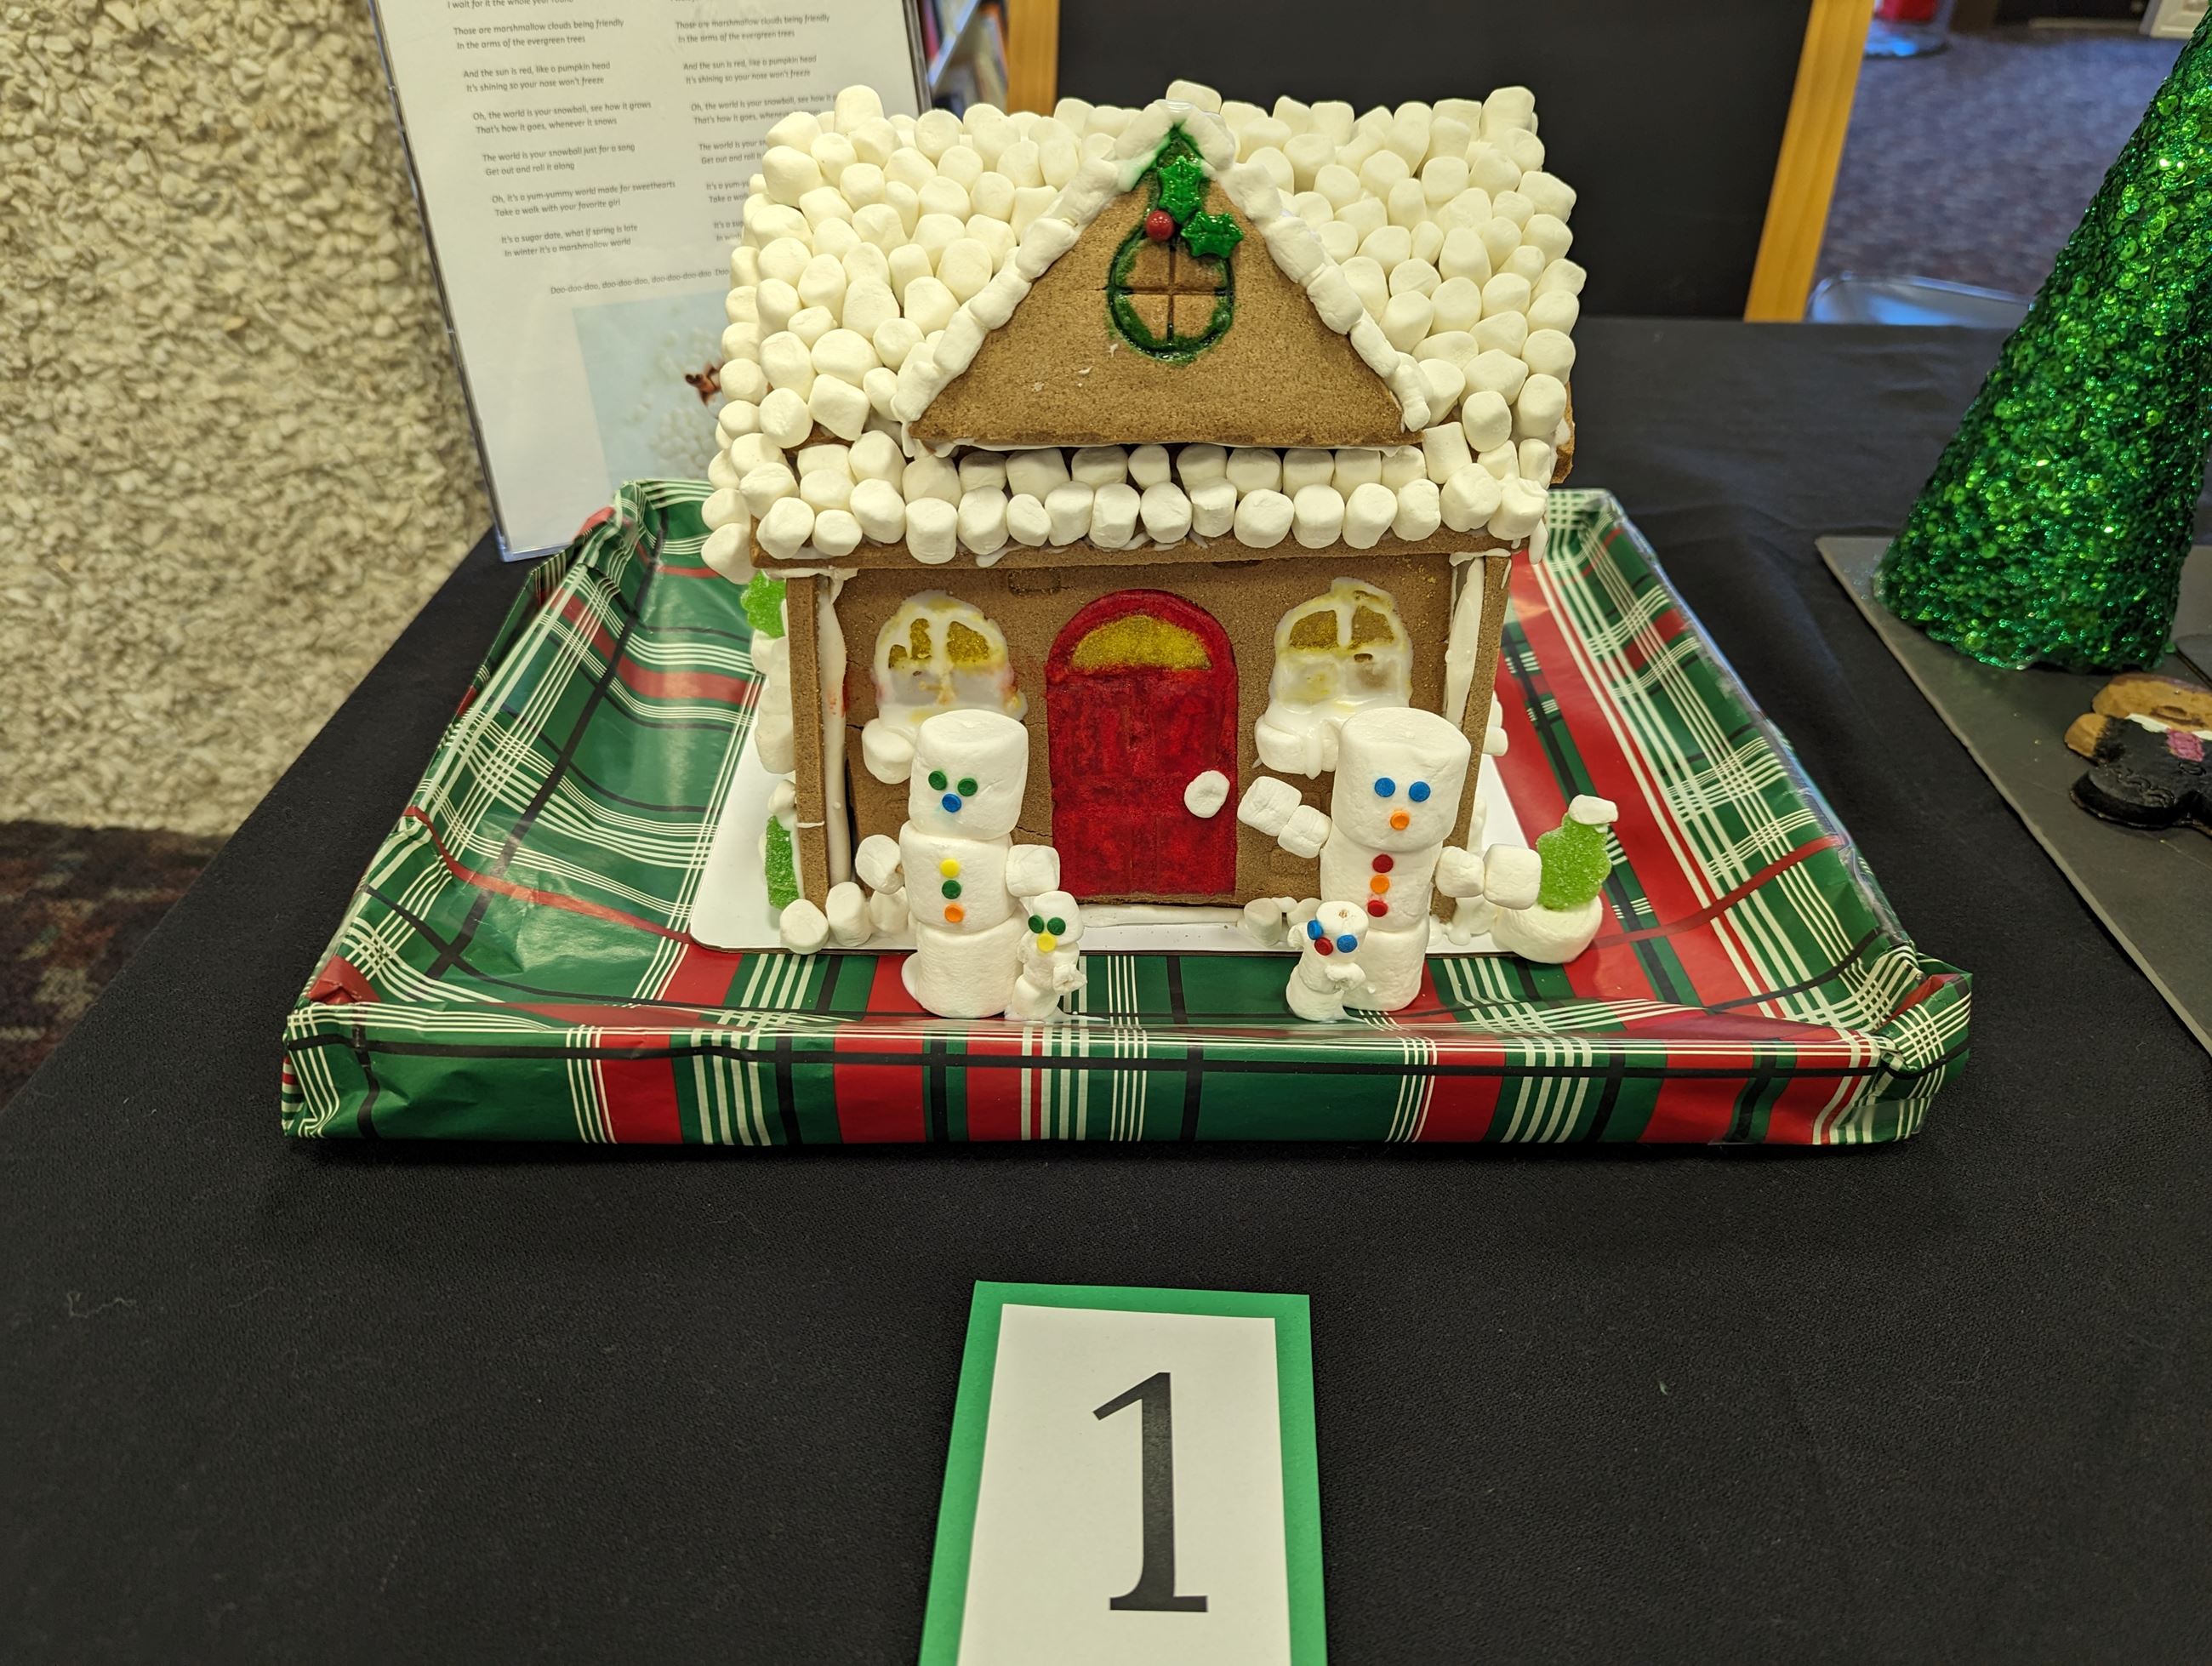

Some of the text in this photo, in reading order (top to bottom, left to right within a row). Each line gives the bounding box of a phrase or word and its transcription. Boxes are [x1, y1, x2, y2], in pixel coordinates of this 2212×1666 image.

[470, 0, 482, 9] for
[493, 23, 546, 32] marshmallow
[548, 21, 572, 30] clouds
[573, 20, 594, 30] being
[596, 19, 624, 30] friendly
[466, 41, 479, 49] the
[527, 38, 565, 47] evergreen
[464, 69, 478, 77] And
[557, 63, 590, 74] pumpkin
[592, 61, 610, 70] head
[480, 83, 508, 92] shining
[520, 83, 537, 91] your
[581, 77, 604, 87] freeze
[504, 109, 524, 118] world
[630, 103, 651, 111] grows
[482, 153, 496, 162] The
[499, 151, 520, 160] world
[530, 151, 546, 160] your
[549, 146, 582, 157] snowball
[583, 145, 596, 156] just
[598, 145, 609, 155] for
[502, 166, 514, 174] out
[533, 163, 544, 172] roll
[554, 163, 574, 171] along
[527, 191, 573, 202] yum-yummy
[575, 187, 596, 196] world
[598, 185, 619, 194] made
[620, 185, 630, 194] for
[632, 180, 676, 191] sweethearts
[495, 208, 513, 217] Take
[522, 205, 539, 214] walk
[542, 203, 558, 213] with
[560, 204, 576, 213] your
[578, 200, 606, 211] favorite
[608, 198, 620, 208] girl
[565, 229, 584, 237] what
[593, 226, 614, 237] spring
[624, 224, 637, 232] late
[514, 248, 538, 256] winter
[560, 241, 608, 252] marshmallow
[610, 237, 630, 247] world
[1092, 1372, 1208, 1612] 1
